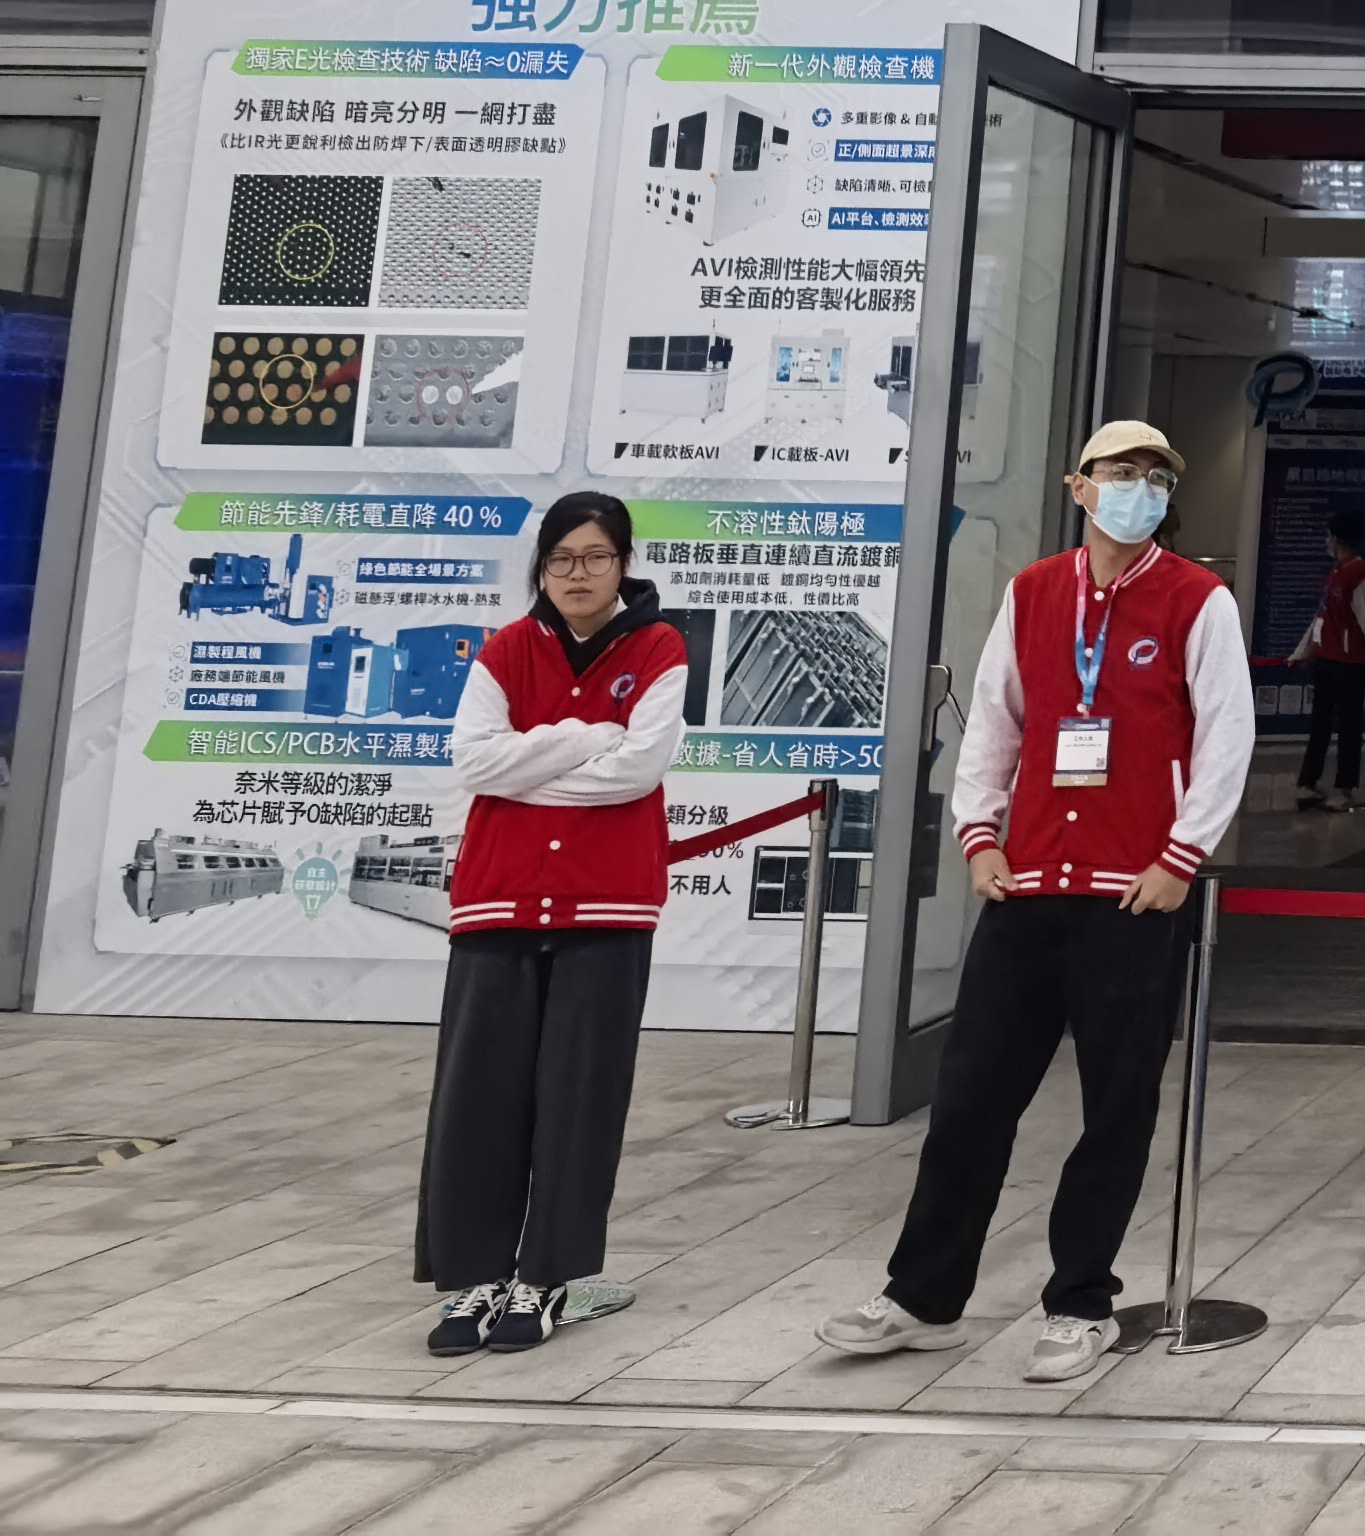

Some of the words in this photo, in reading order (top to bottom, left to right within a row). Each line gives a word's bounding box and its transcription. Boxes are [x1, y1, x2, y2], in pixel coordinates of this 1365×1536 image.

[246, 47, 430, 73] 獨家E光檢查技術
[728, 53, 936, 80] 新一代外觀檢查機
[234, 98, 334, 124] 外觀缺陷
[345, 100, 446, 124] 暗亮分明
[454, 101, 557, 126] 一網打盡
[690, 256, 925, 283] AVI檢測性能大幅領先
[698, 285, 916, 313] 更全面的客製化服務
[220, 499, 437, 529] 節能先鋒/耗電直降
[444, 505, 474, 528] 40
[479, 505, 502, 528] %
[707, 509, 866, 537] 不溶性鈦陽極
[234, 770, 393, 798] 奈米等級的潔淨
[192, 800, 434, 828] 為芯片賦予0缺陷的起點
[670, 874, 731, 896] 不用人
